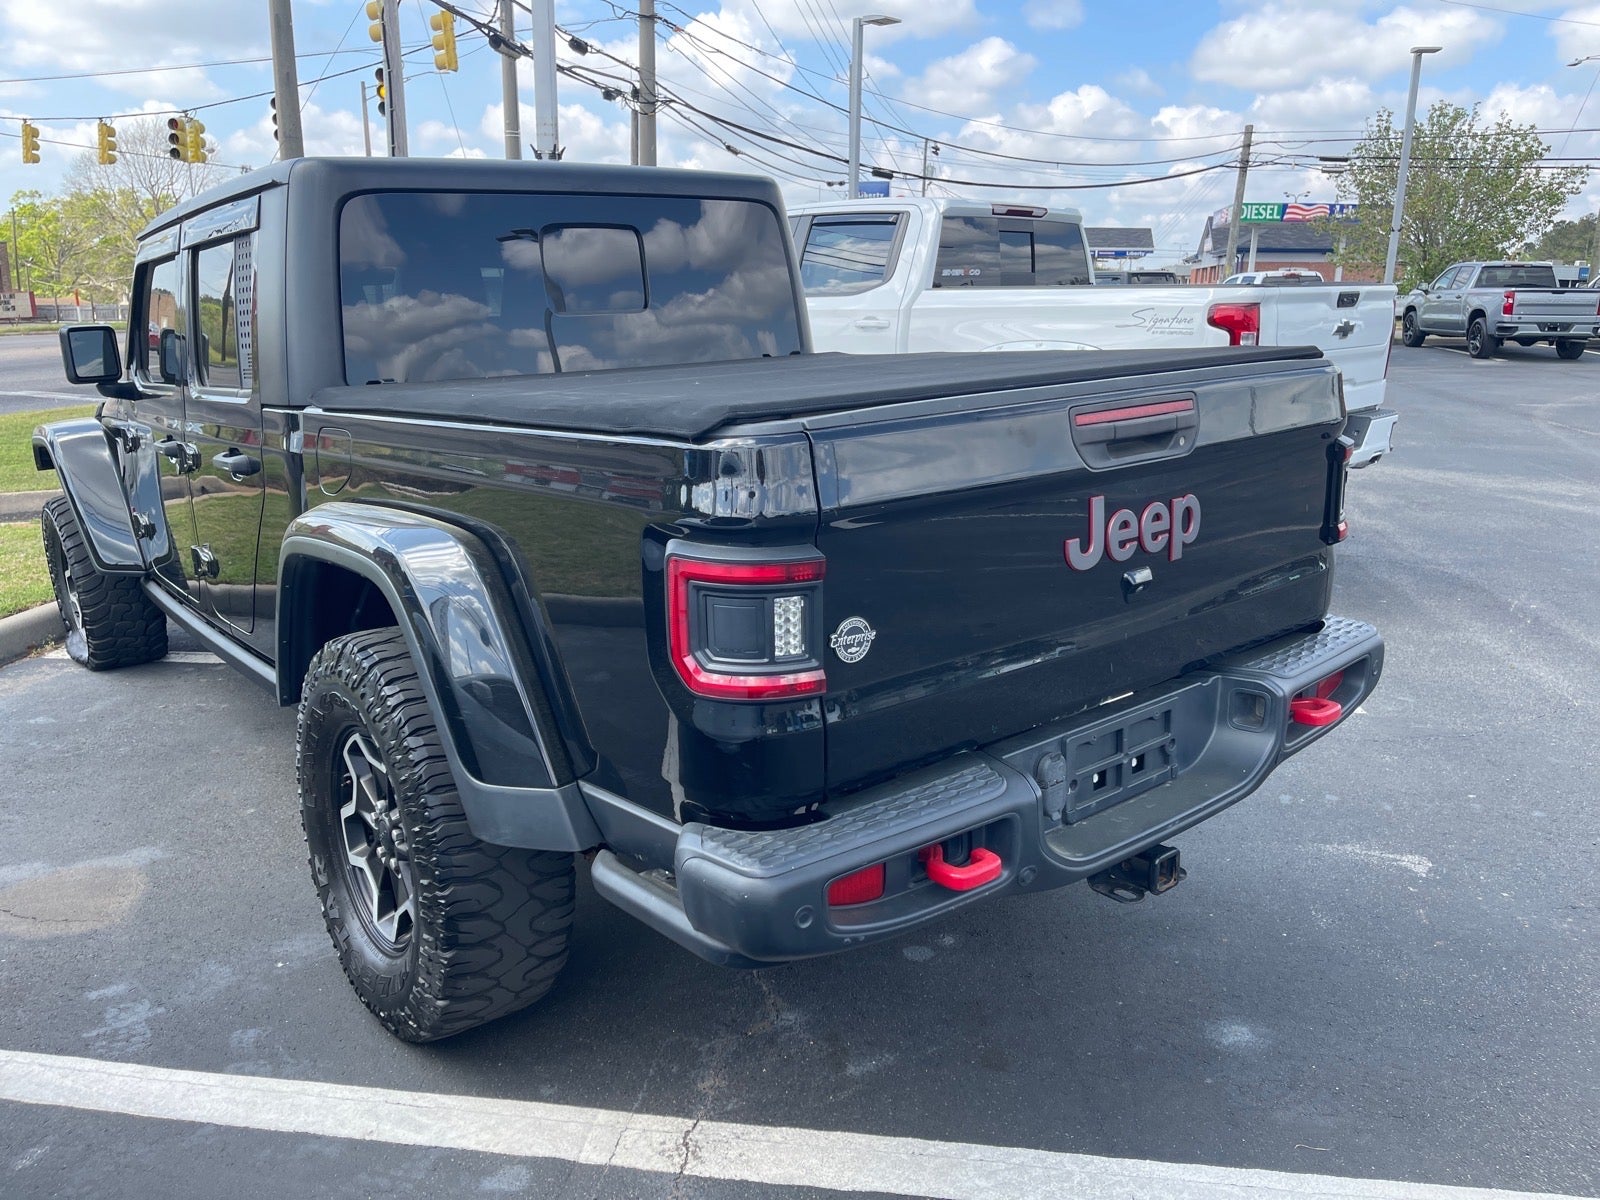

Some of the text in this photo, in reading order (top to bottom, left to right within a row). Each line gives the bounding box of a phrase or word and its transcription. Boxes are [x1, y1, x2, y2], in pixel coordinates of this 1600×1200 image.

[1240, 204, 1280, 219] DIESEL
[1115, 307, 1194, 332] Signature
[1064, 494, 1201, 571] Jeep
[830, 629, 877, 648] Enterprise
